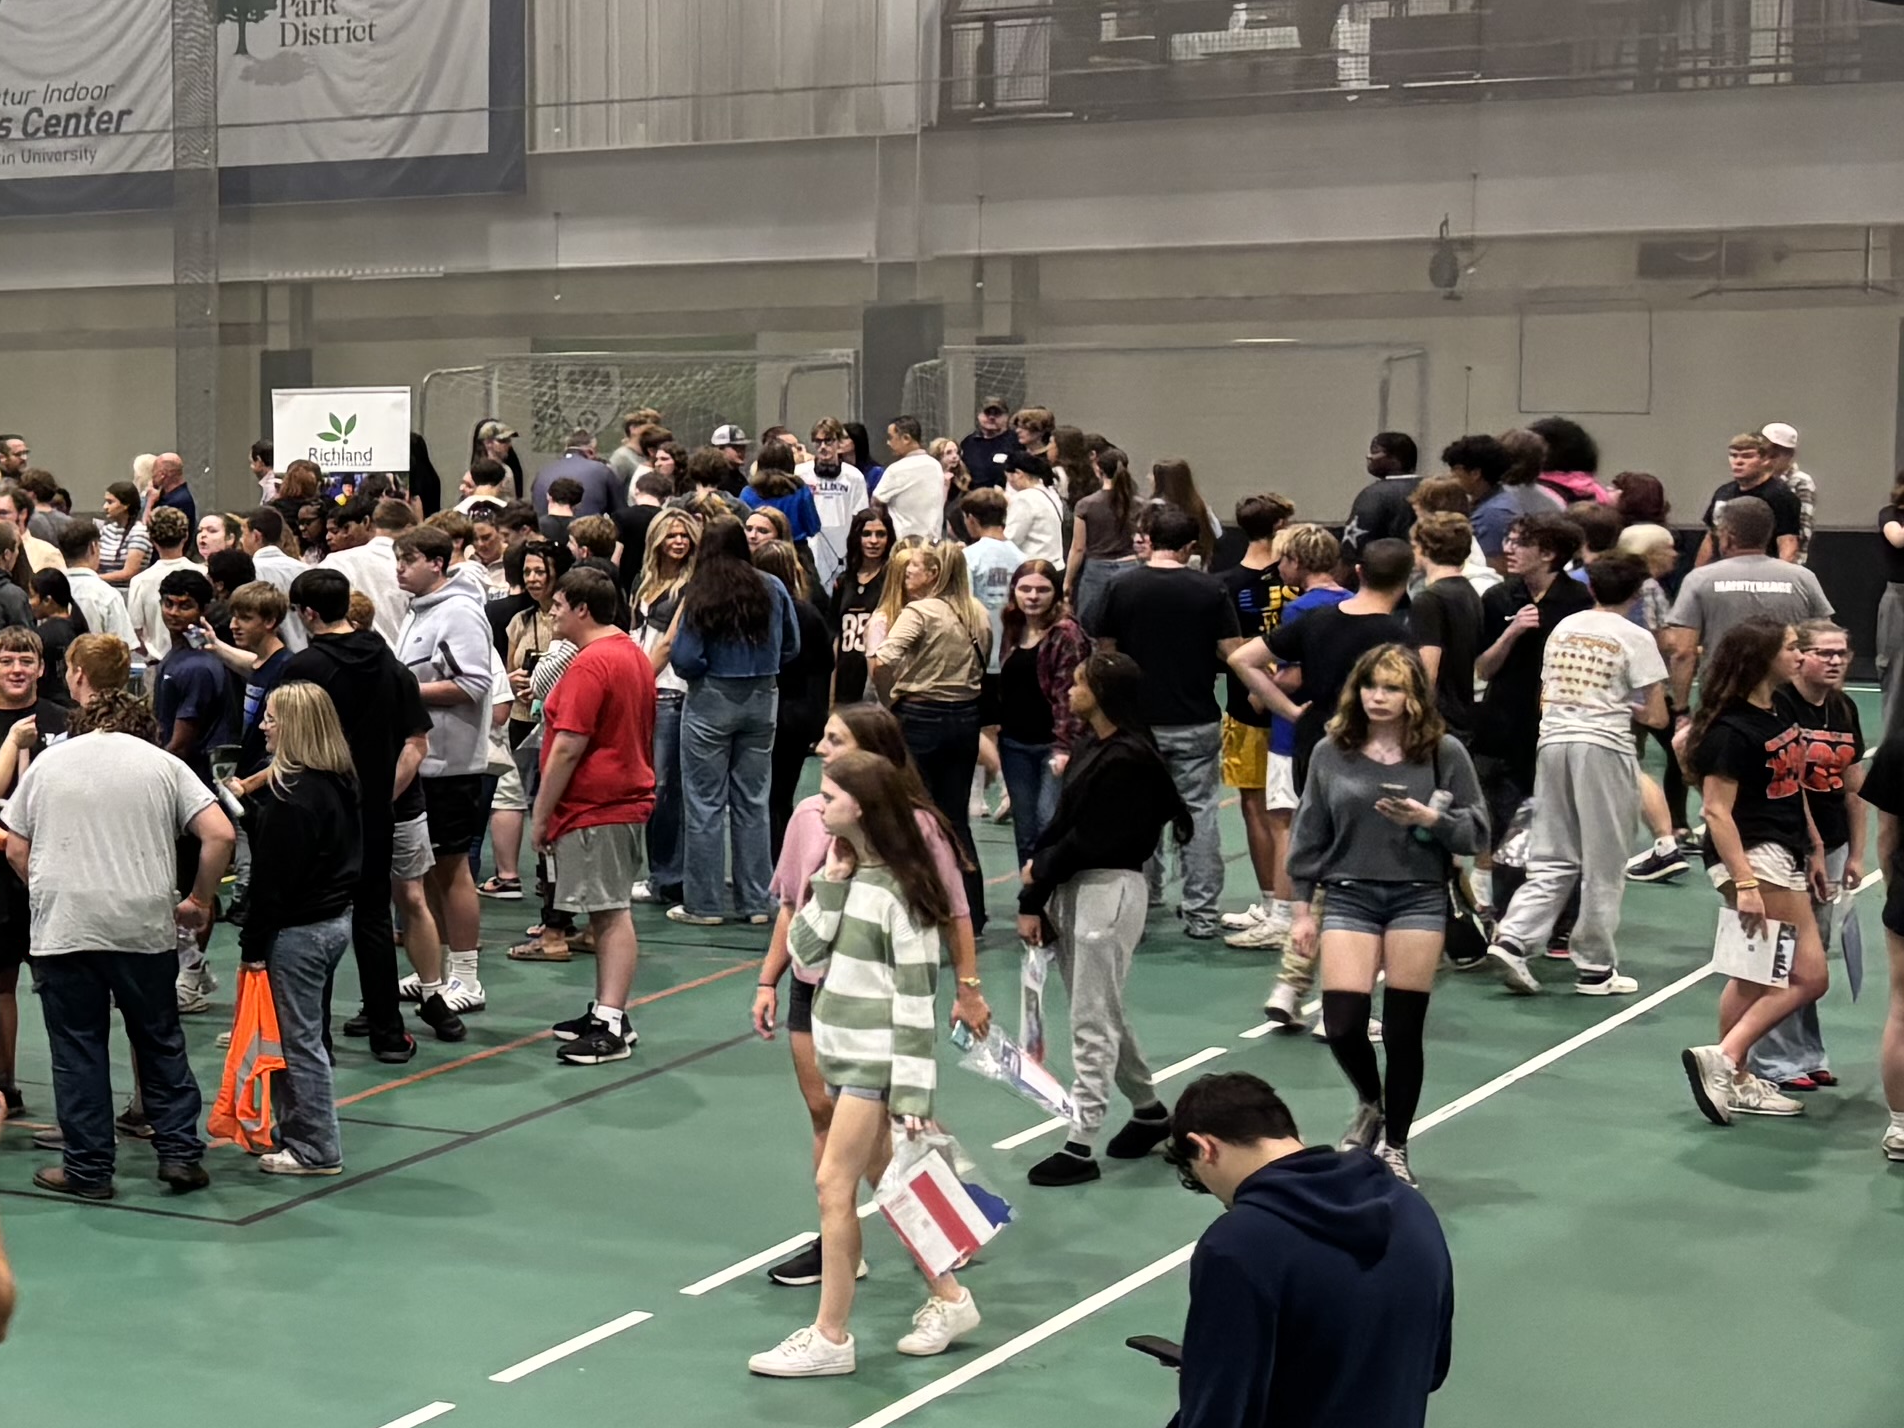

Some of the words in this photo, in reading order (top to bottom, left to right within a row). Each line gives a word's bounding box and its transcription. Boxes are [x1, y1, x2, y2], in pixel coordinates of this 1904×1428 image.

[279, 19, 377, 47] District
[42, 81, 115, 105] Indoor
[21, 106, 133, 139] Center
[21, 146, 98, 166] University
[309, 447, 373, 463] Richland
